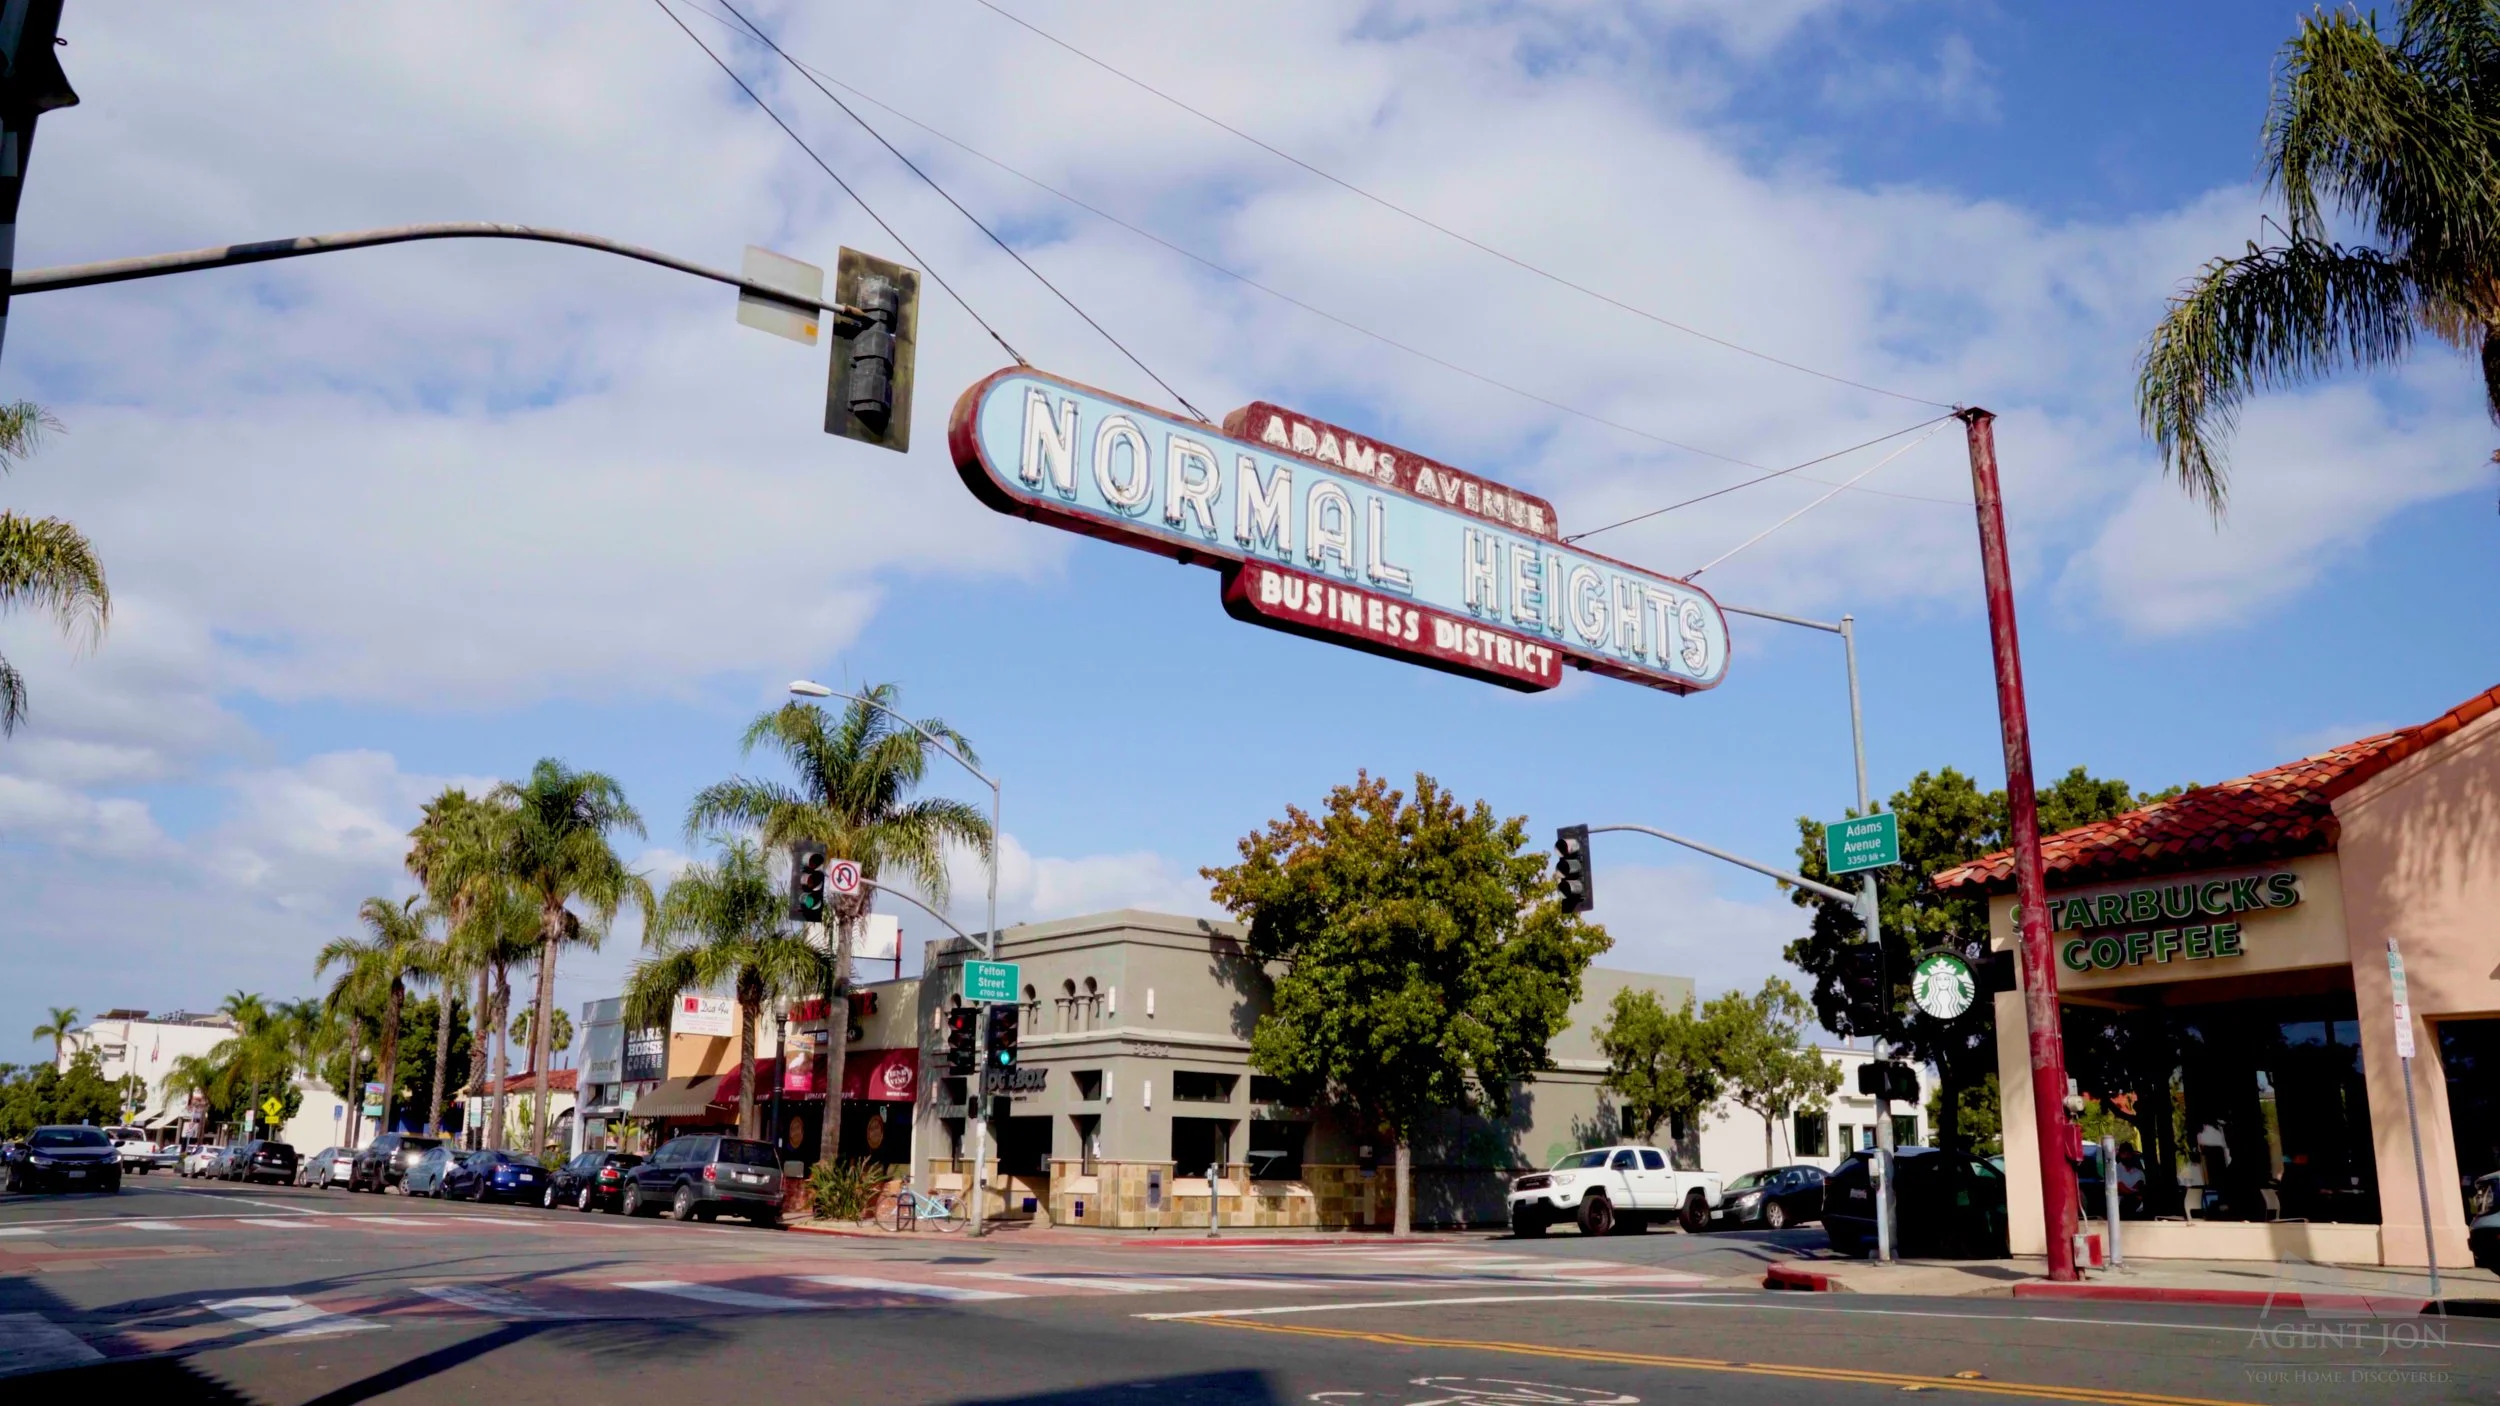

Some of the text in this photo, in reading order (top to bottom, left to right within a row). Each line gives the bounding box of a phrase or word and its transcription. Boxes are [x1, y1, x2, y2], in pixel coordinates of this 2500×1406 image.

[1262, 415, 1547, 534] ADAMS AVENUE
[1020, 386, 1710, 676] NORMAL HEIGHTS
[1260, 570, 1553, 676] BUSINESS DISTRICT
[1846, 822, 1883, 837] Adams
[1843, 838, 1882, 854] Avenue
[1847, 854, 1867, 866] 3350
[2061, 921, 2244, 972] COFFEE
[978, 965, 1006, 976] Felton
[978, 977, 1005, 988] Street
[627, 1041, 664, 1057] HORSE
